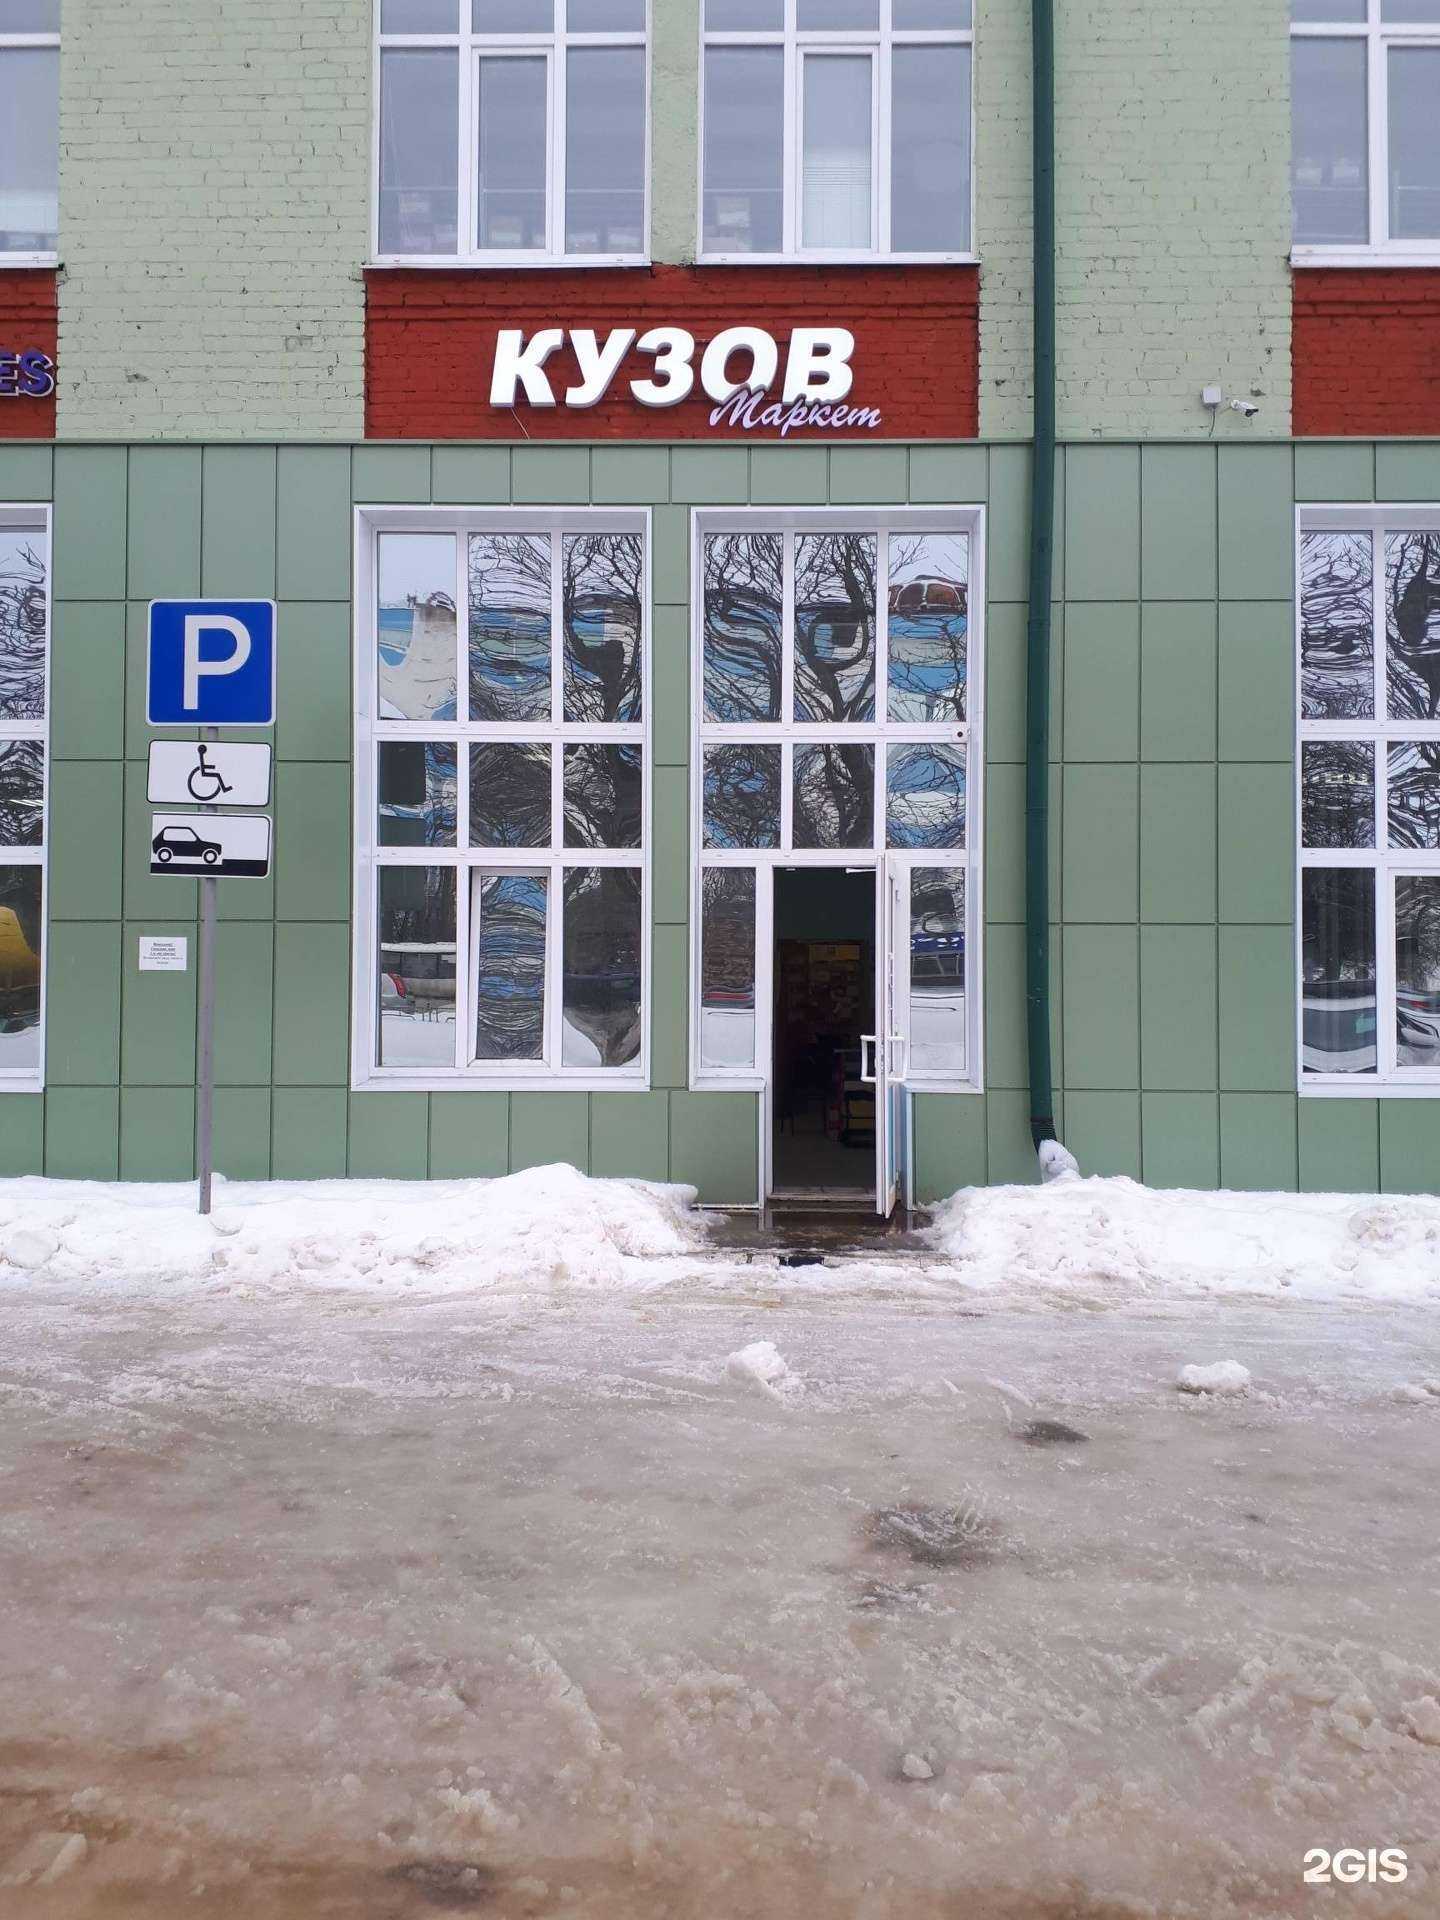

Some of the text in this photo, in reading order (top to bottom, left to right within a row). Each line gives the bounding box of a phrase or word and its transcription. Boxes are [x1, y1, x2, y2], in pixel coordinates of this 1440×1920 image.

[489, 326, 855, 409] КУЗОВ
[709, 388, 882, 437] Маркет
[183, 614, 252, 710] P
